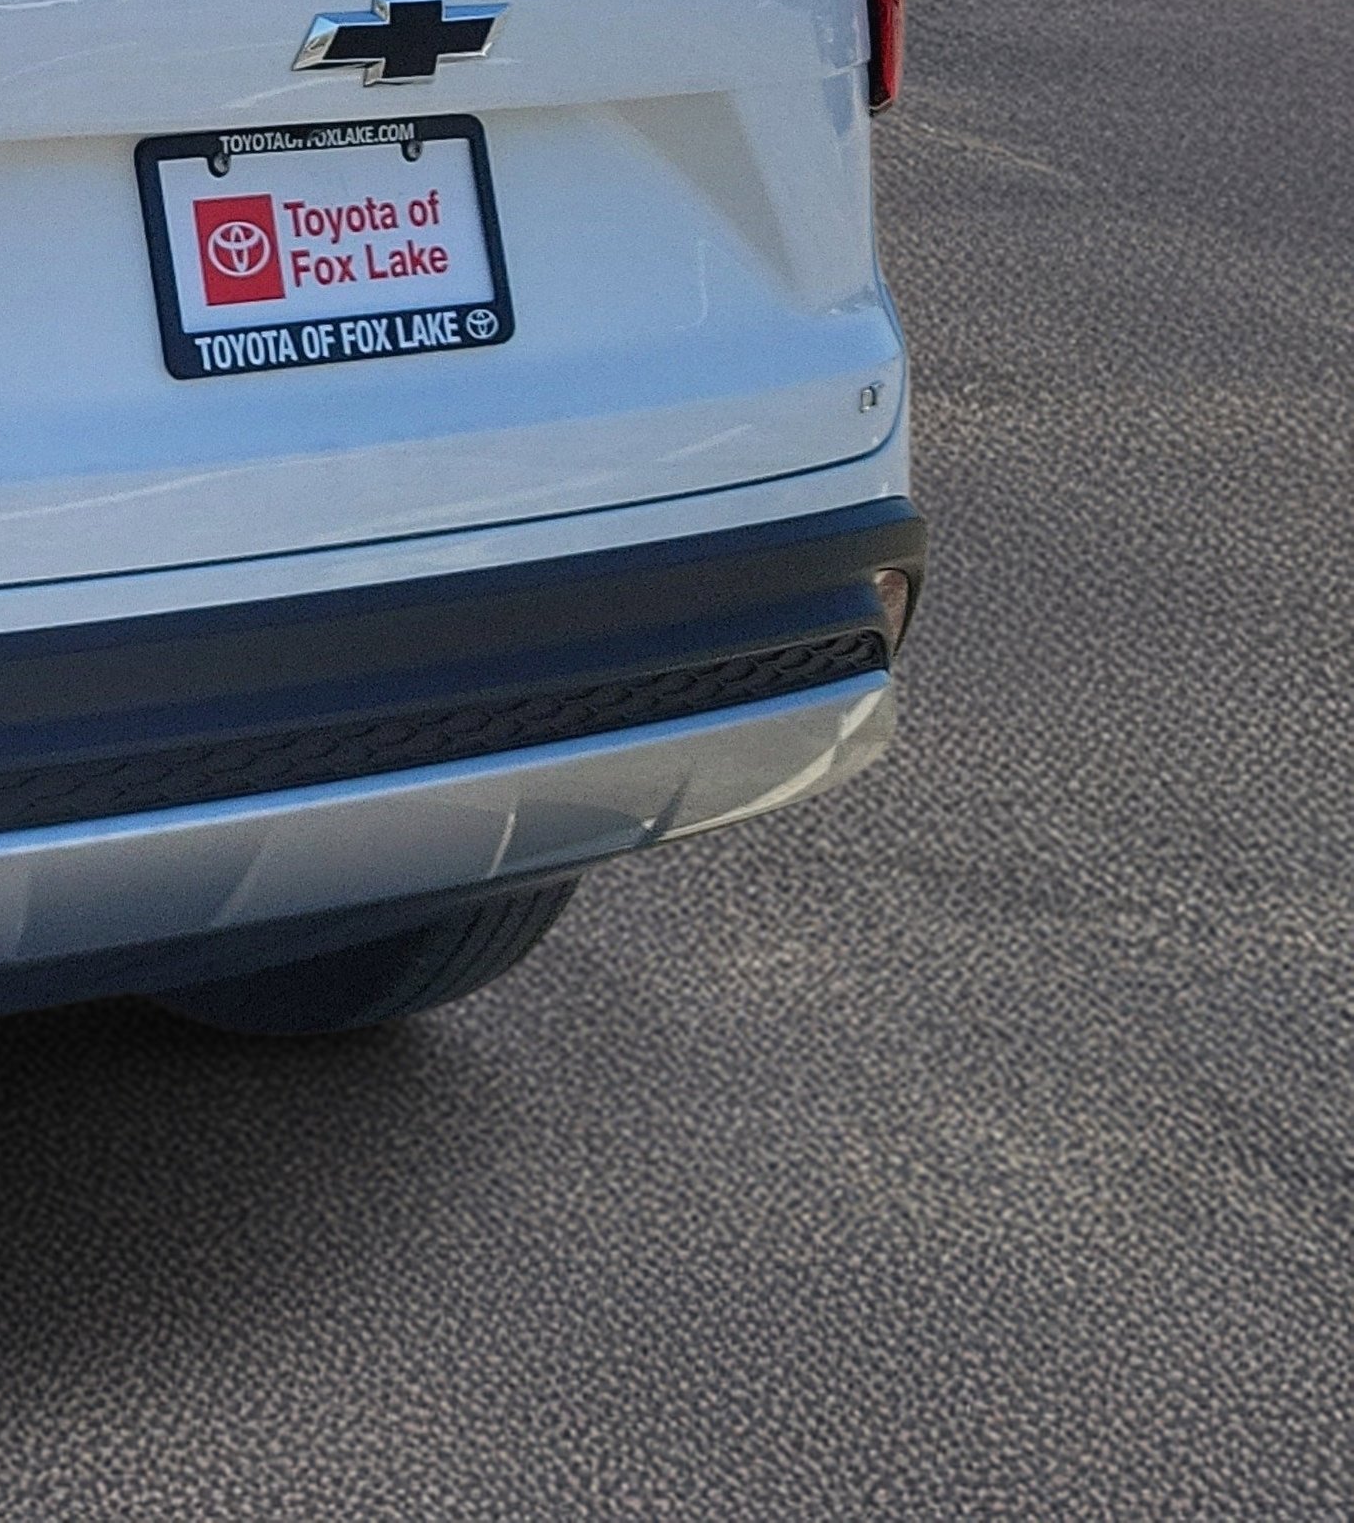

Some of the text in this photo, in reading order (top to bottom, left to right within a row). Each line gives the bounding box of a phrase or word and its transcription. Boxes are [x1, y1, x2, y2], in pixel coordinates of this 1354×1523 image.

[282, 189, 440, 245] Toyota of
[289, 239, 449, 288] Fox Lake
[194, 310, 462, 372] TOYOTA OF FOX LAKE
